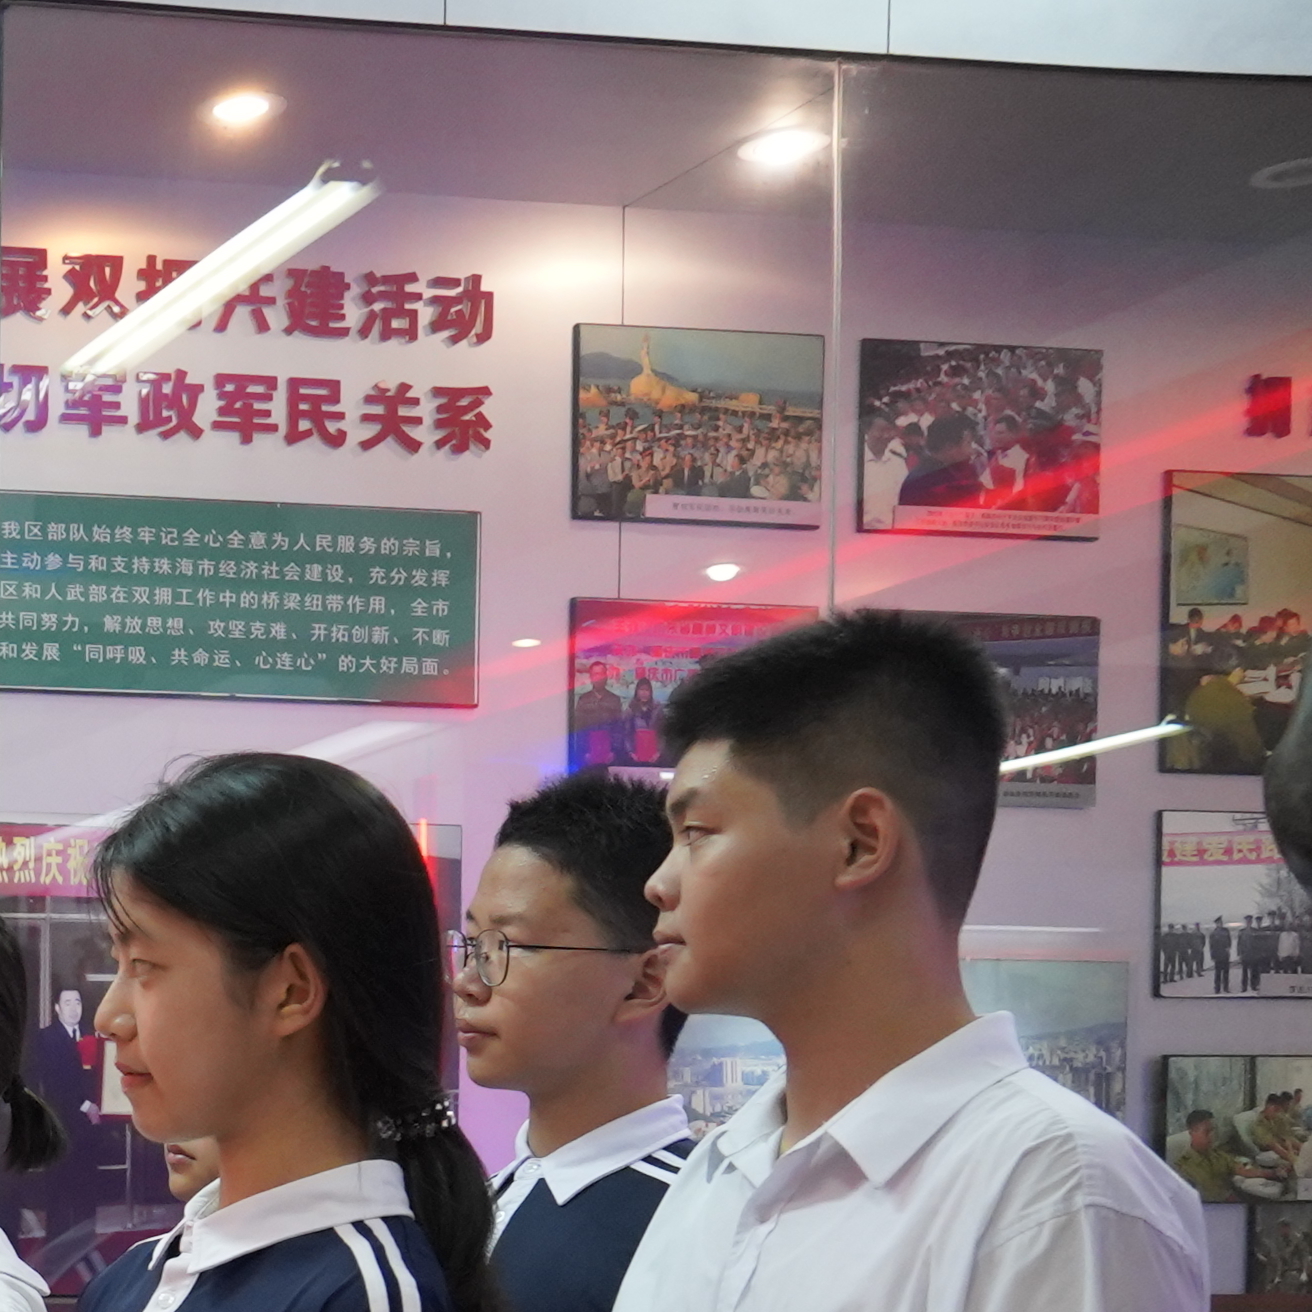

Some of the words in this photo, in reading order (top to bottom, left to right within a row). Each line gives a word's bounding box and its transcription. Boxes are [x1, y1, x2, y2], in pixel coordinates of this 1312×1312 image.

[1, 521, 452, 559] 我区部队始终牢记全心全意为人民服务的宗旨,
